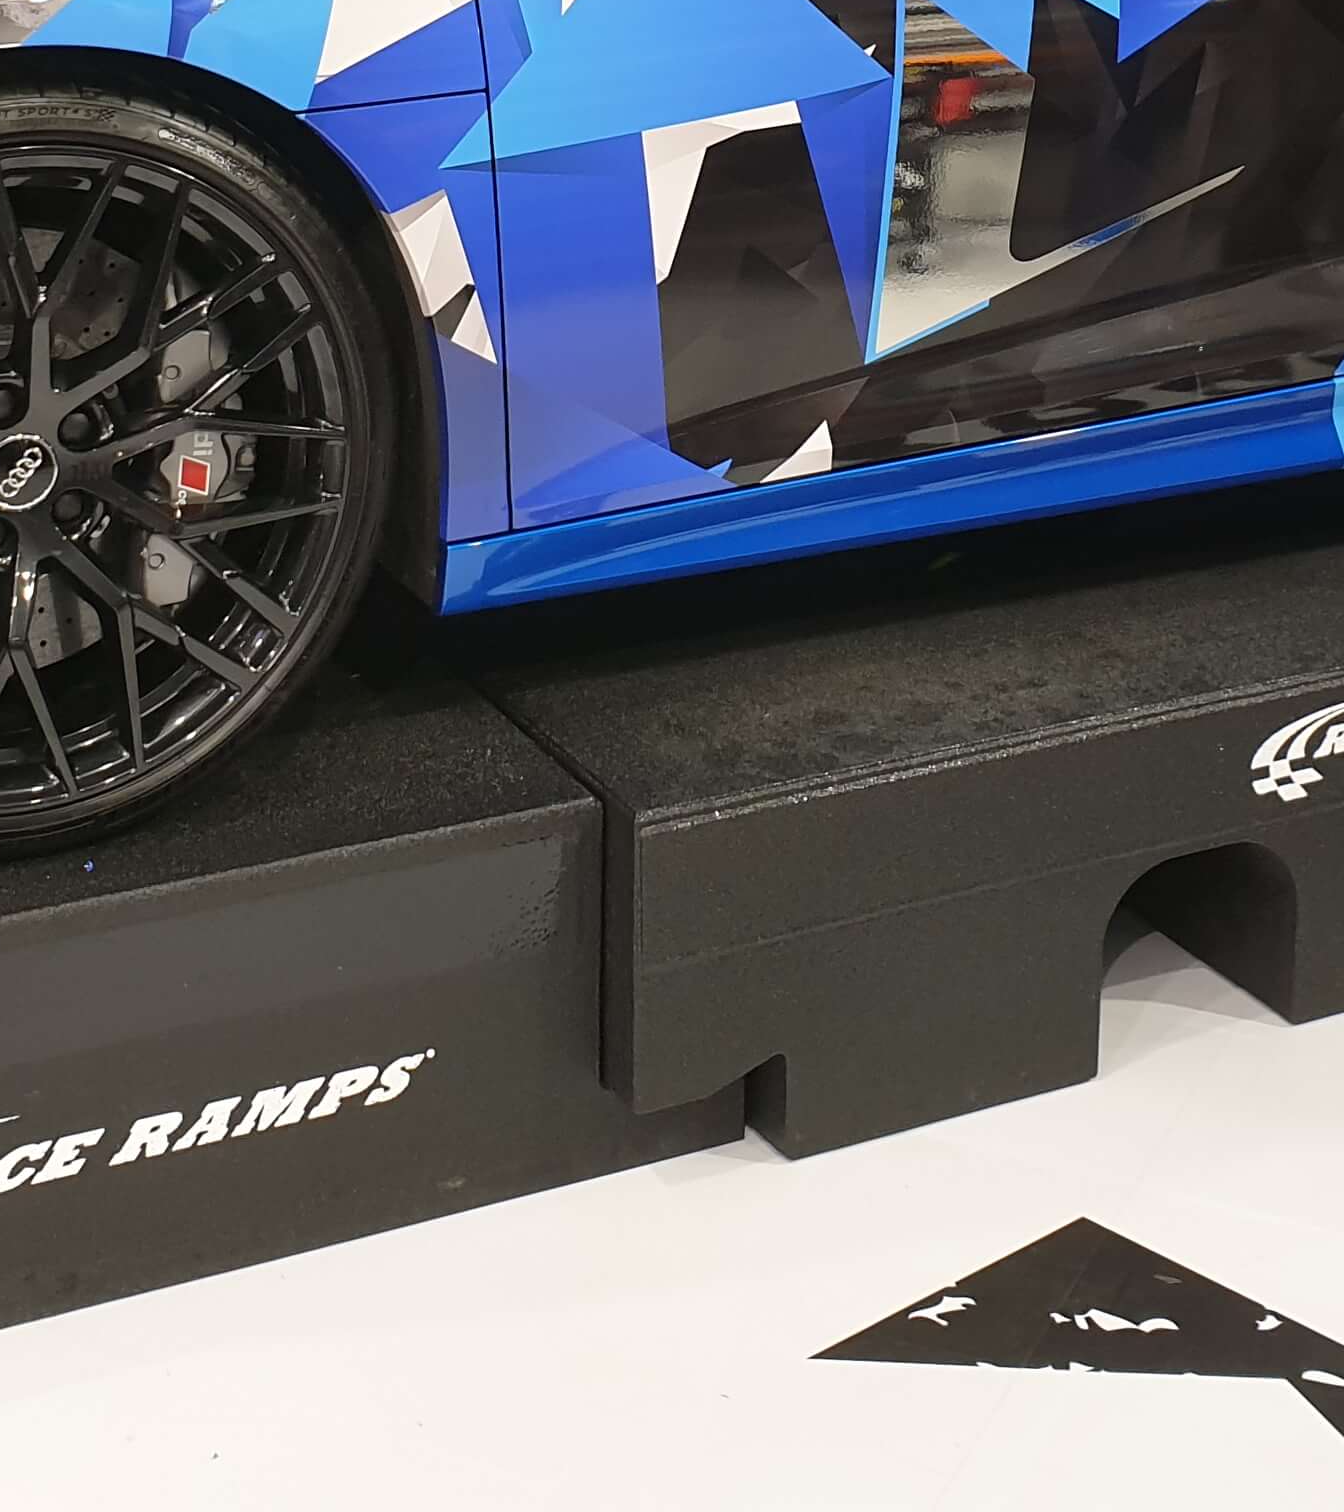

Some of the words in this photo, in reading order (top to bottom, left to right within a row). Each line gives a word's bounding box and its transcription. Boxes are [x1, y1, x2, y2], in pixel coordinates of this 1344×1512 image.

[17, 107, 69, 120] SPORT
[193, 432, 215, 457] di
[109, 1051, 427, 1167] RAMPS
